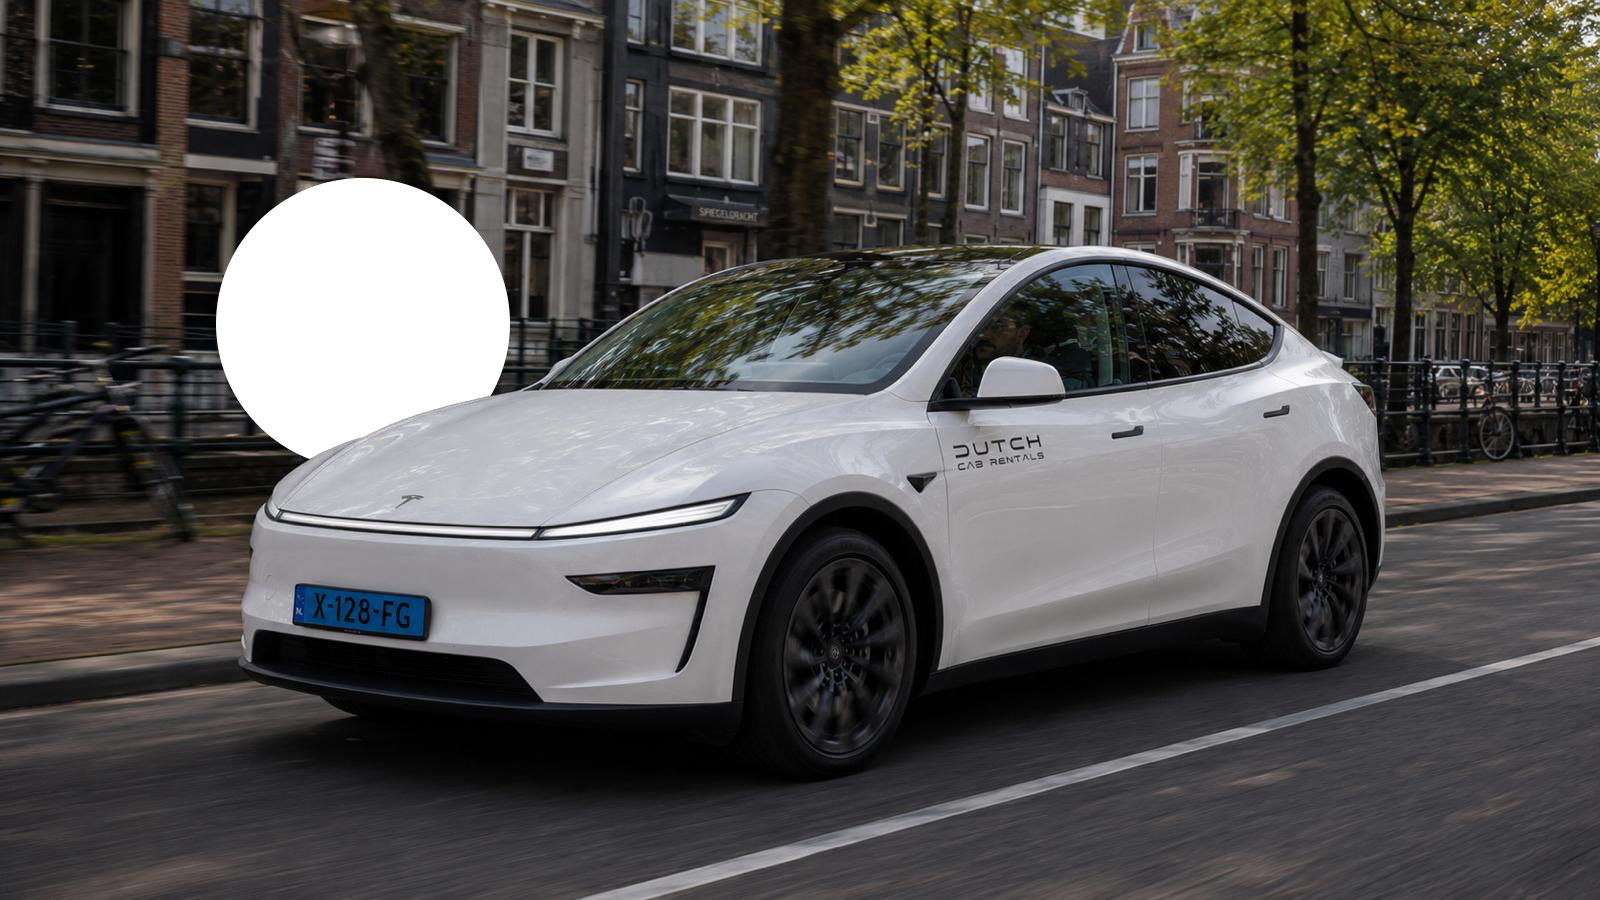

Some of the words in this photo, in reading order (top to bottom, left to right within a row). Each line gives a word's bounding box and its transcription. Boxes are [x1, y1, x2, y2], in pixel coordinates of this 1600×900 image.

[953, 434, 1042, 459] DUTCH
[957, 460, 984, 471] CAB
[989, 451, 1045, 466] RENTALS
[312, 592, 410, 629] X-128-FG
